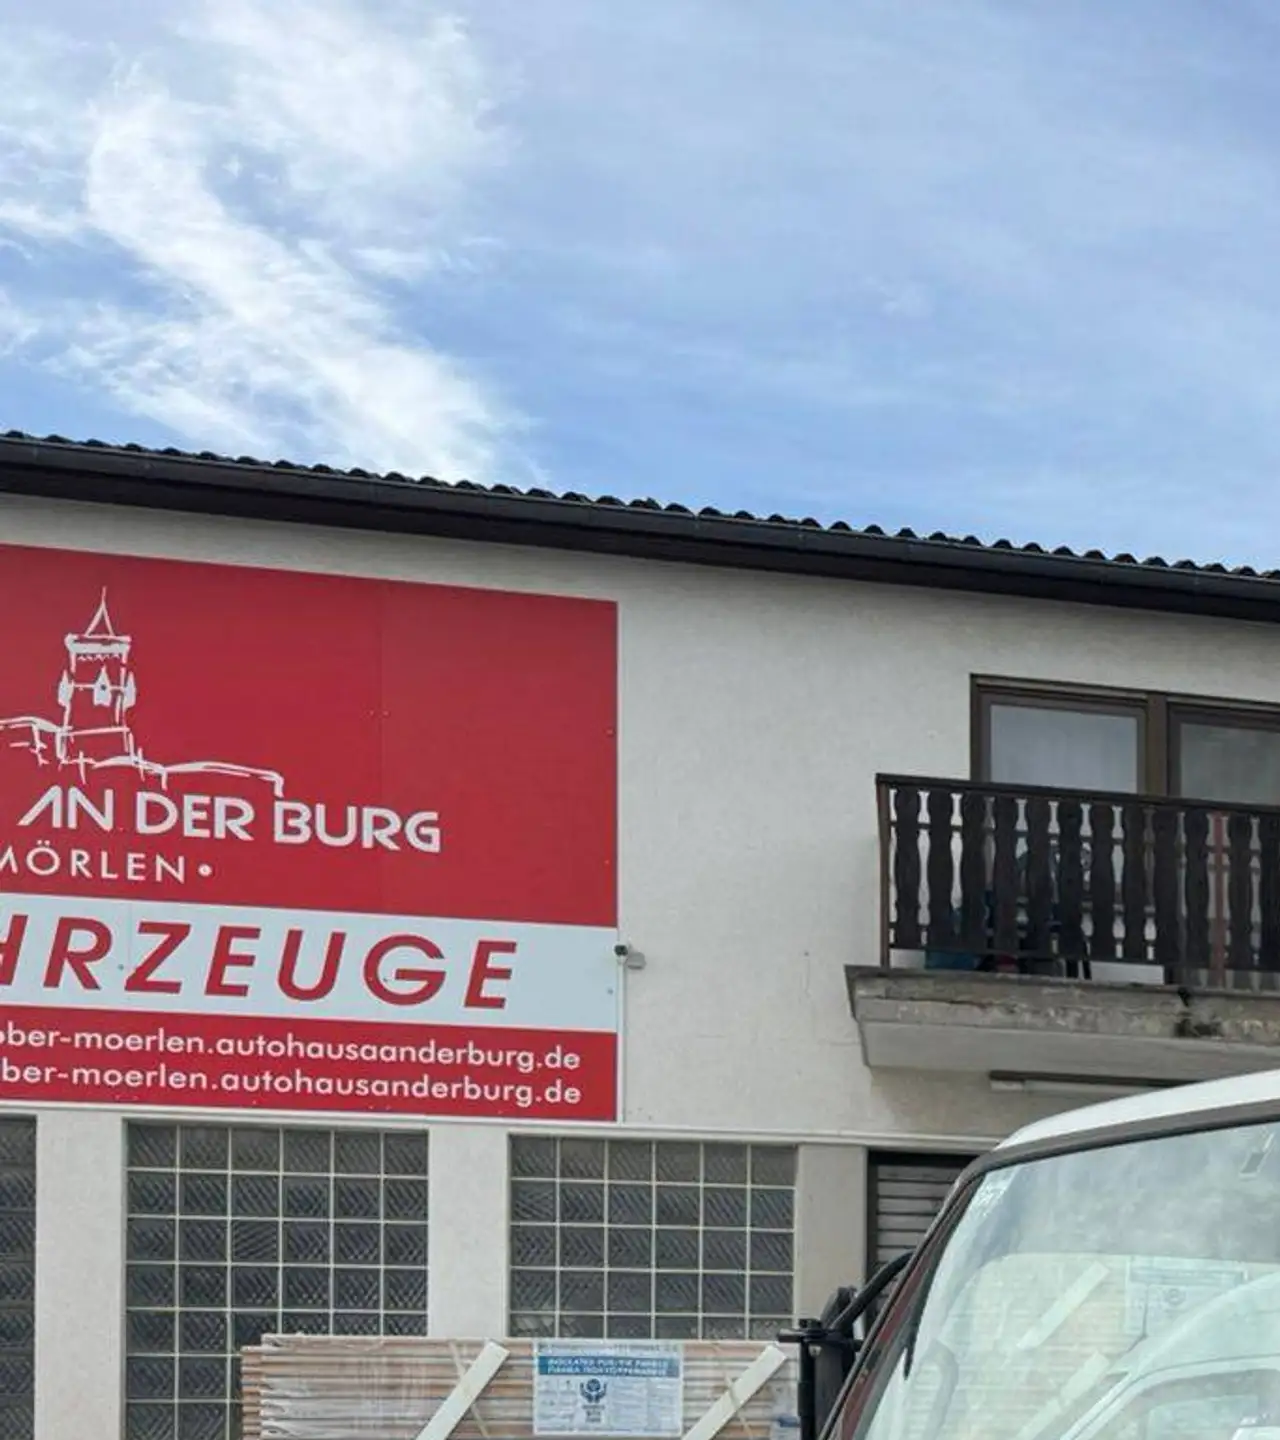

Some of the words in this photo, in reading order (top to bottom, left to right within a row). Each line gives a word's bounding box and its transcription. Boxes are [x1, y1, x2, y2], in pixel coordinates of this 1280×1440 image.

[16, 784, 115, 832] AN
[136, 790, 254, 841] DER
[274, 799, 441, 853] BURG
[0, 1019, 581, 1073] ber-moerlen.autohausaanderburg.de
